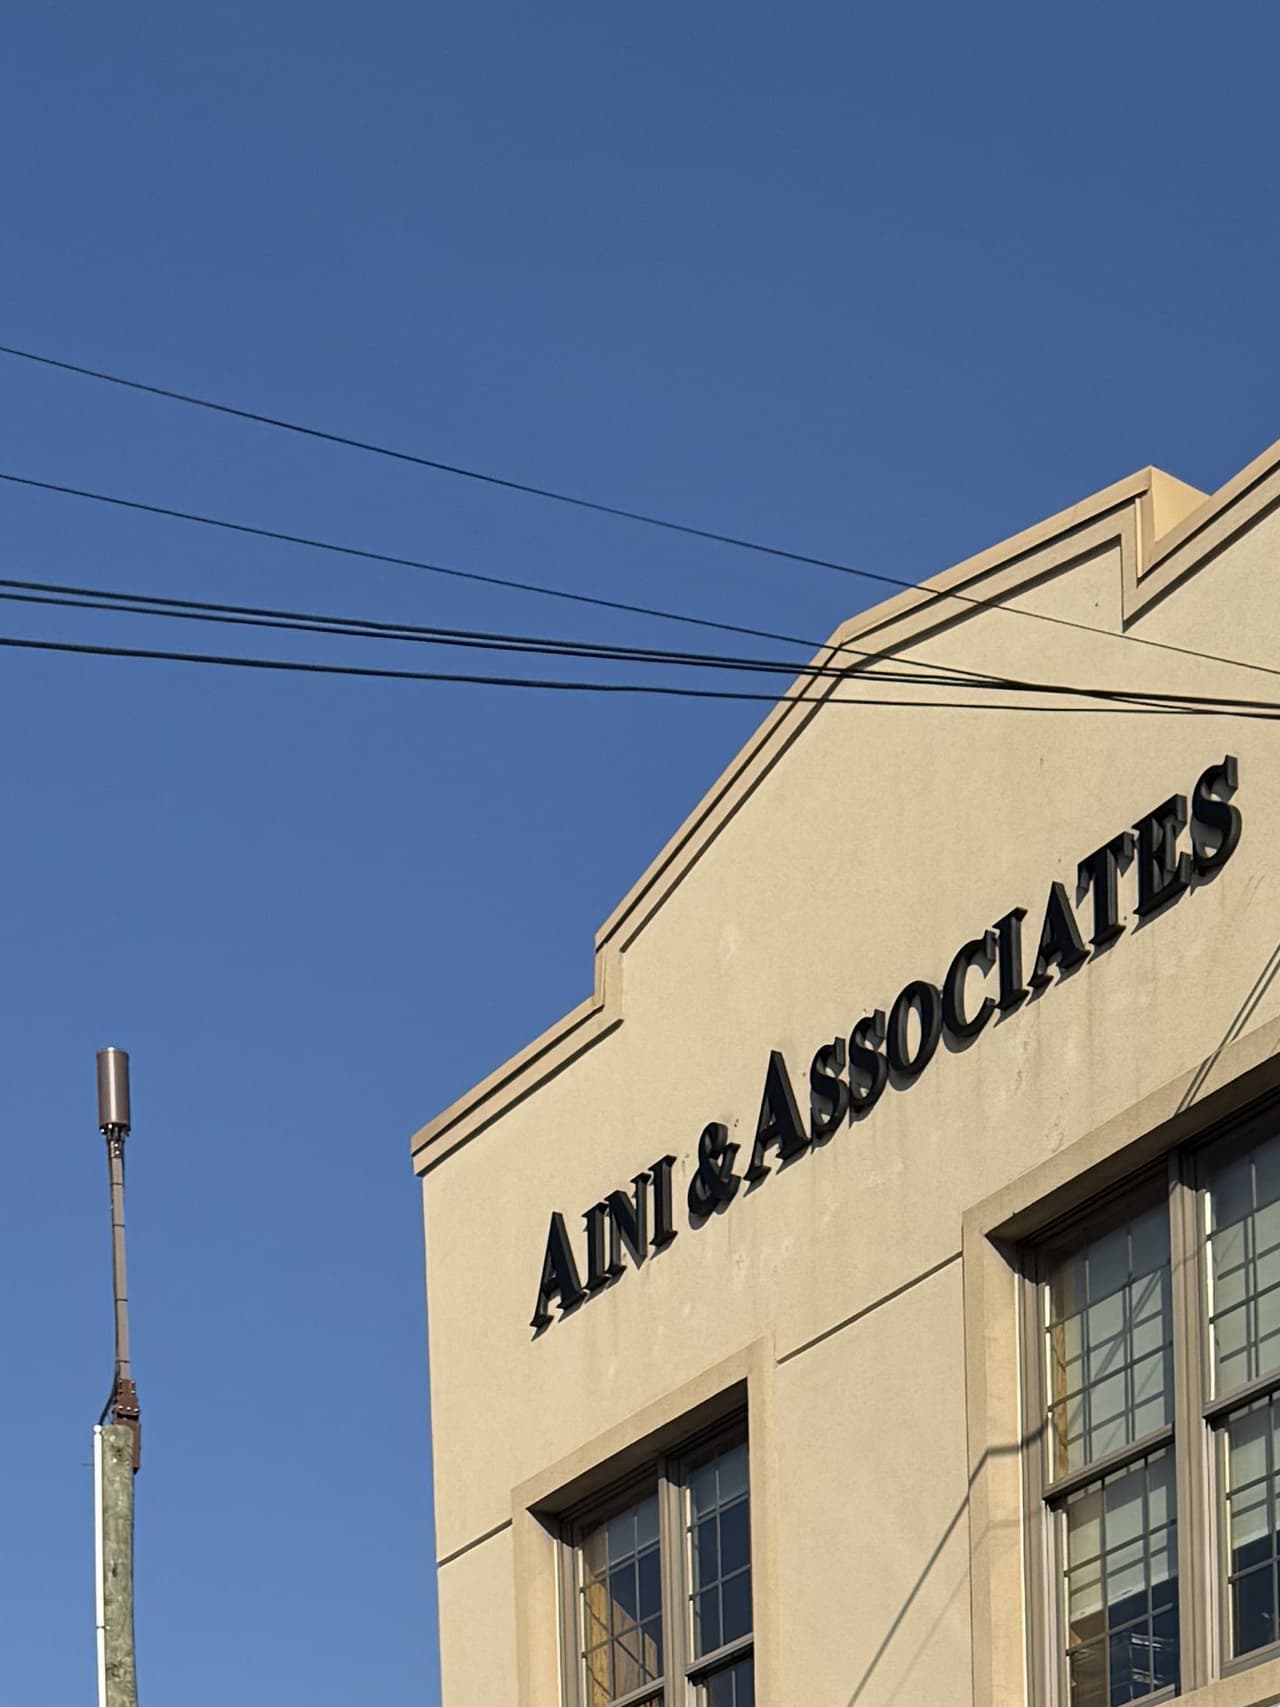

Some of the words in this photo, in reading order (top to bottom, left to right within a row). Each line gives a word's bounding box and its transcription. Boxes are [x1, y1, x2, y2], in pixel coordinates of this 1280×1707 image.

[529, 1154, 679, 1336] AINI
[687, 1122, 742, 1228] &
[744, 755, 1243, 1185] ASSOCIATES
